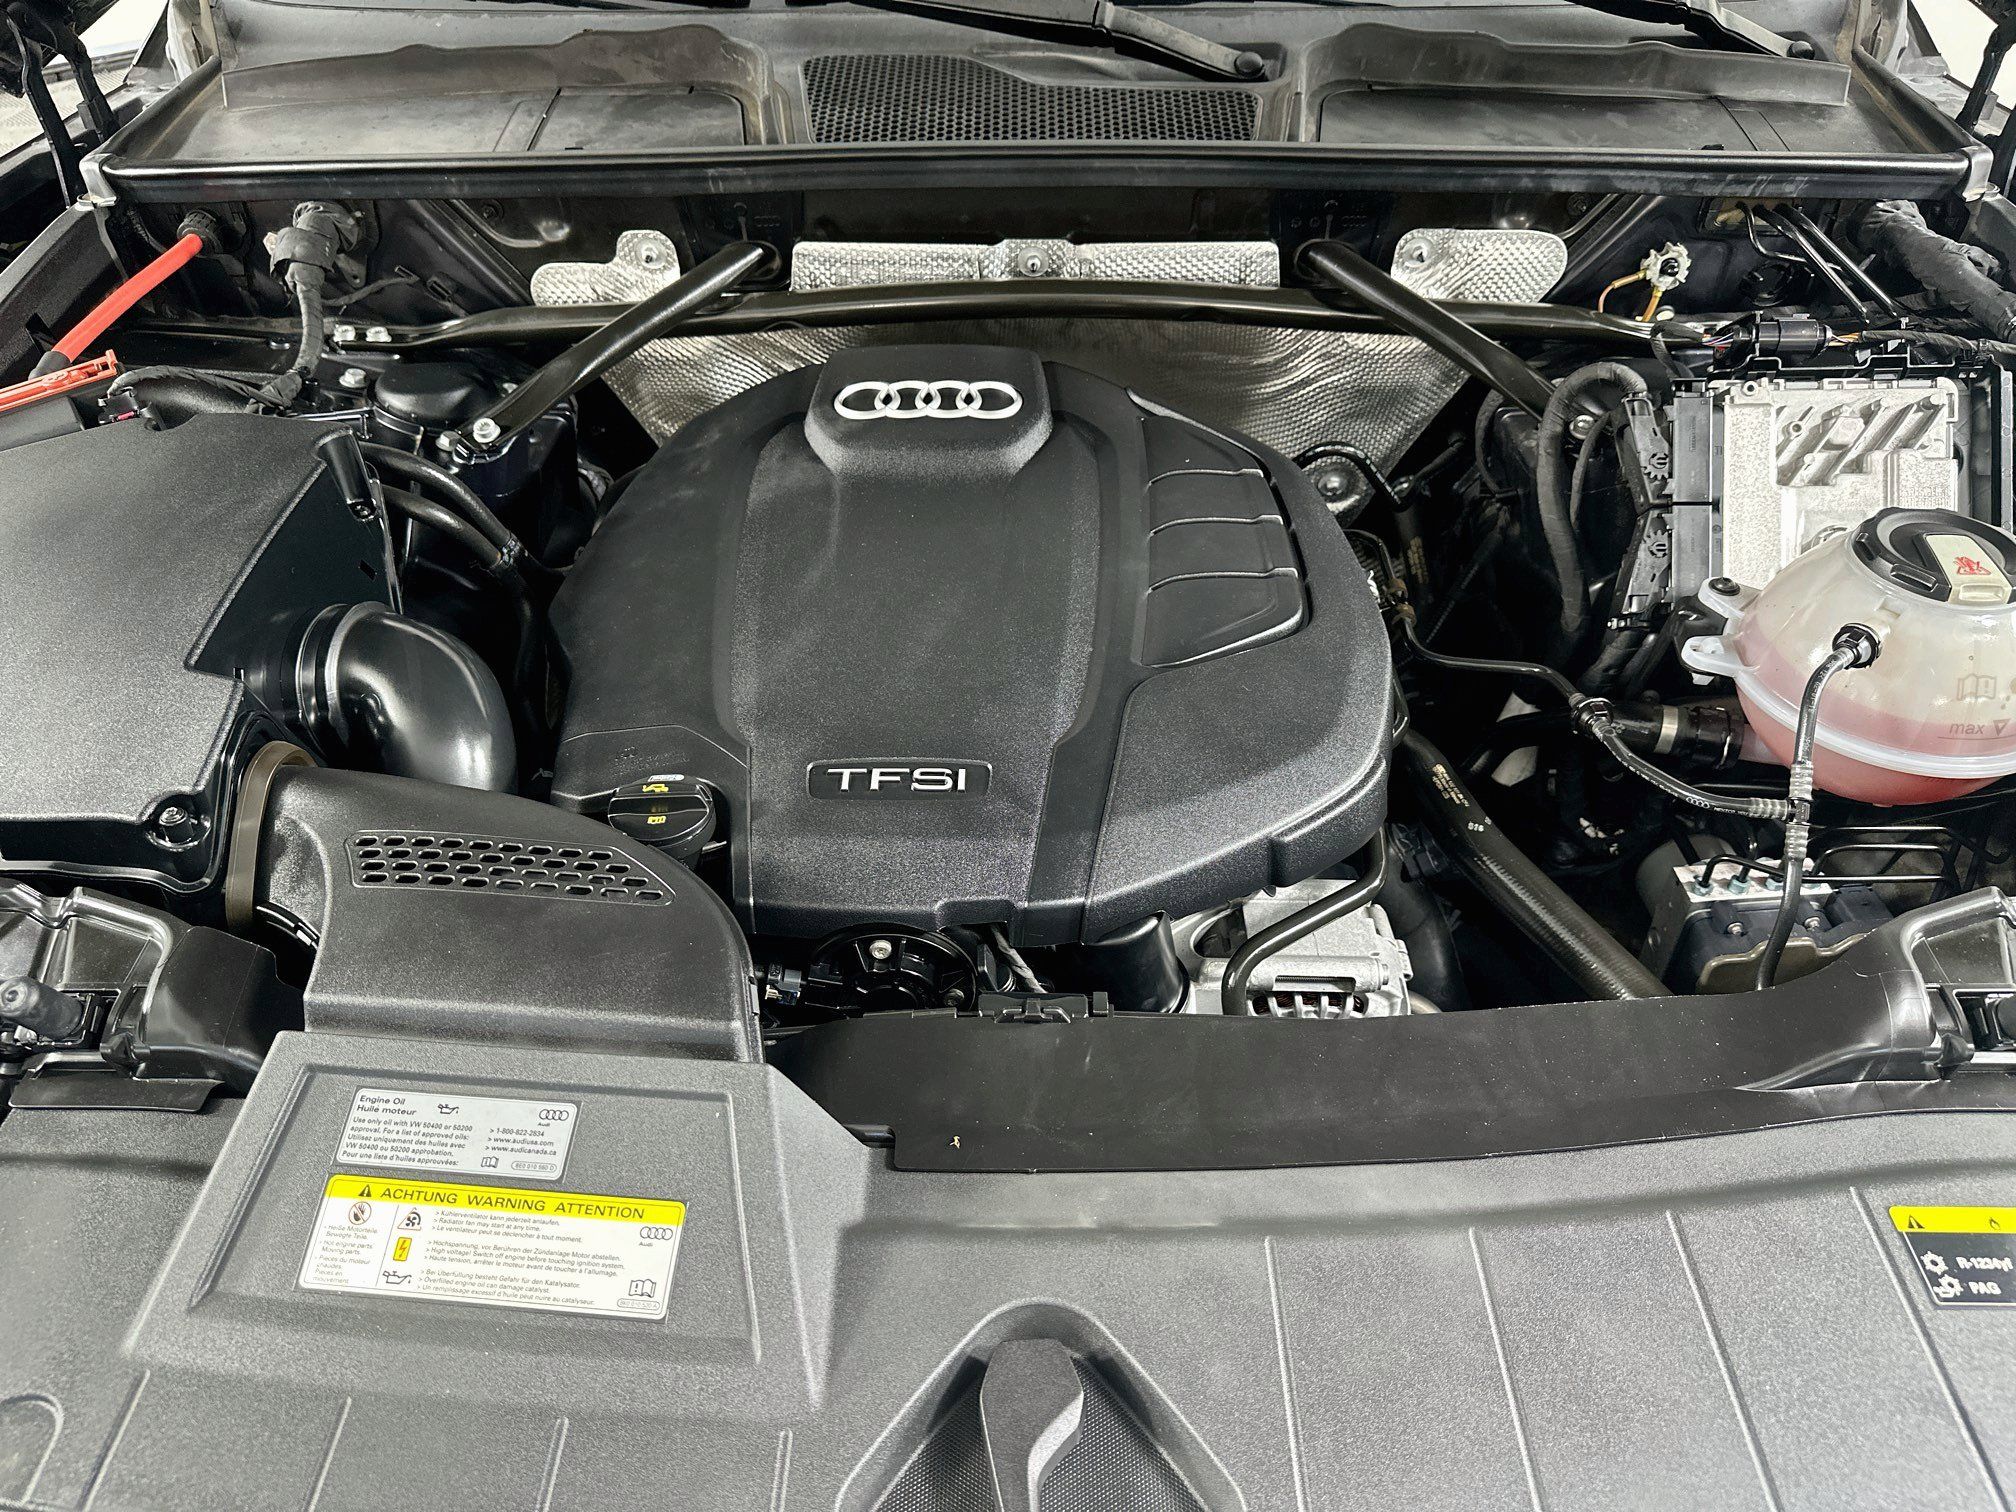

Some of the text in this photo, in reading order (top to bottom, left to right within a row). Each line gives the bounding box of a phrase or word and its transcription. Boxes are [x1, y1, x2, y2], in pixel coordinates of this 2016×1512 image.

[1949, 723, 1985, 735] max
[827, 768, 966, 792] TFSI
[359, 1094, 406, 1105] Engine Oil
[356, 1104, 379, 1113] Huile
[367, 1118, 382, 1126] only
[422, 1121, 443, 1129] 50400
[452, 1124, 473, 1132] 50200
[347, 1133, 372, 1141] Utilisez
[373, 1135, 414, 1145] uniquement
[414, 1138, 426, 1146] des
[428, 1140, 448, 1148] huiles
[421, 1131, 454, 1139] approved
[493, 1137, 554, 1146] www.audiusa.com
[358, 1142, 379, 1151] 50400
[389, 1145, 410, 1153] 50200
[491, 1146, 557, 1155] www.audicanada.ca
[373, 1152, 388, 1160] liste
[380, 1187, 644, 1219] ACHTUNG WARNING ATTENTION
[438, 1217, 464, 1225] Radiator
[430, 1247, 445, 1255] High
[472, 1249, 494, 1257] Switch
[526, 1255, 547, 1263] before
[548, 1257, 575, 1266] touching
[1968, 1281, 2002, 1295] PAG
